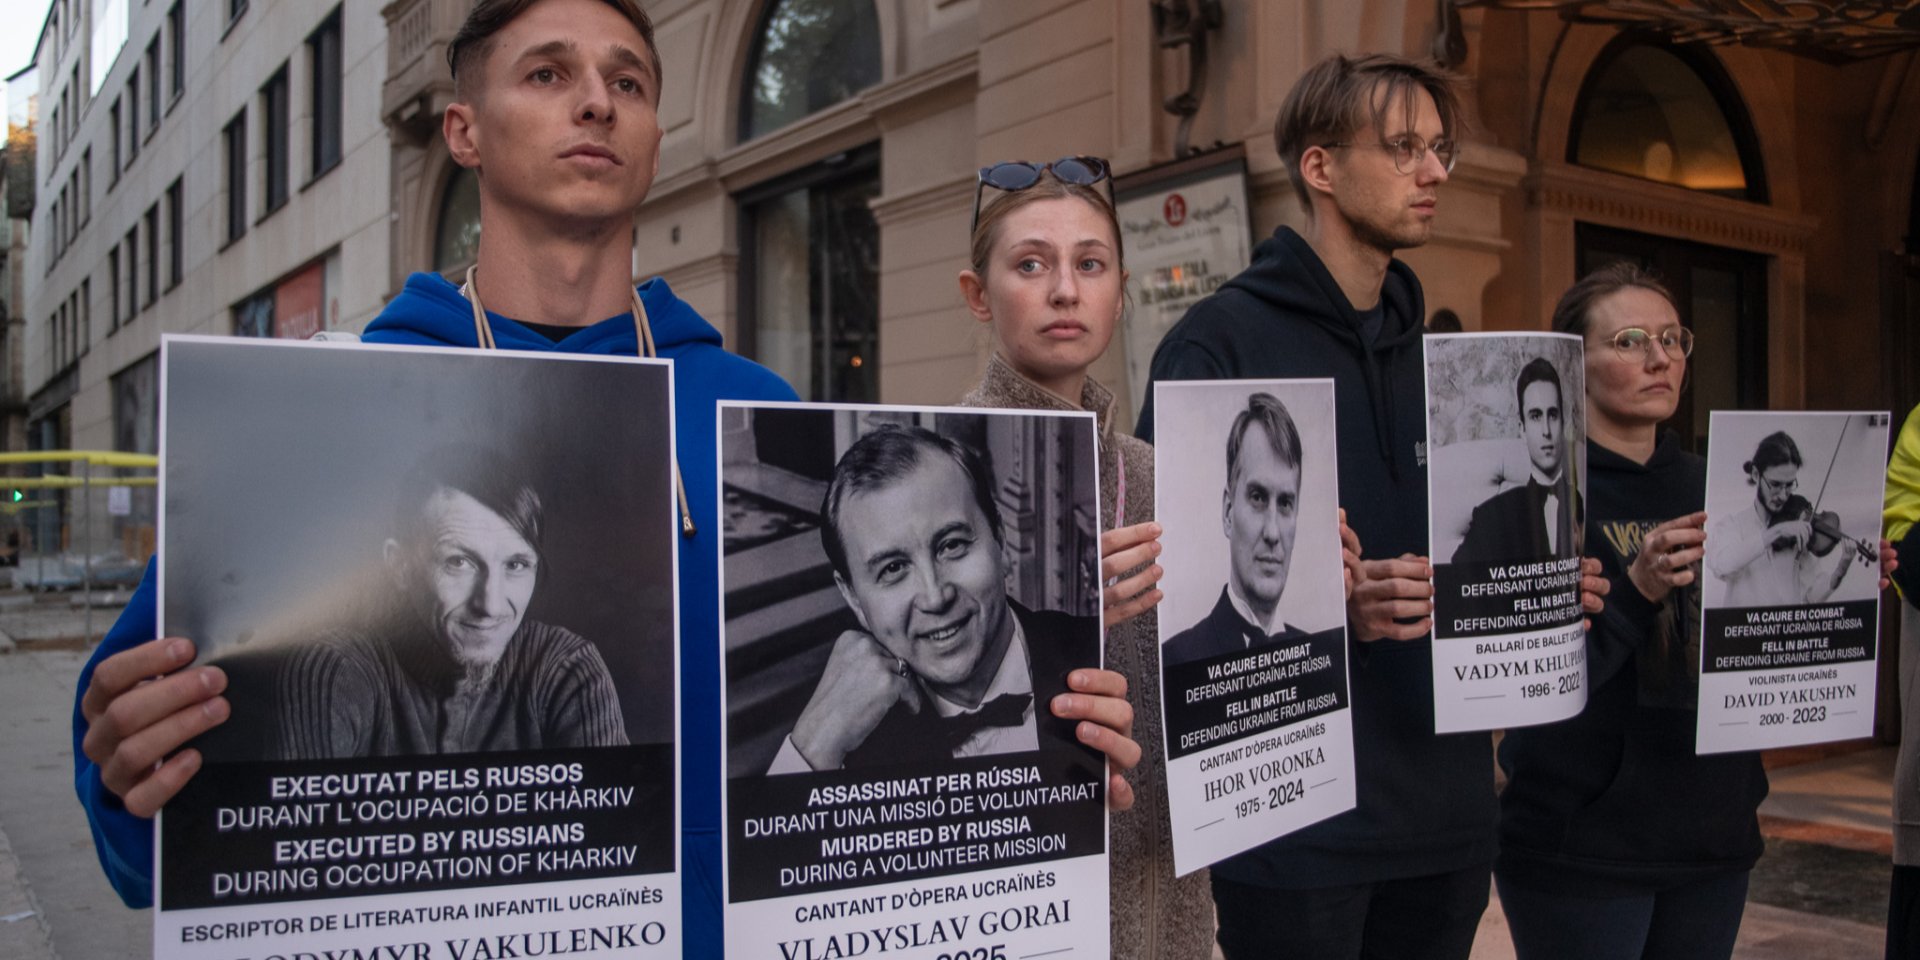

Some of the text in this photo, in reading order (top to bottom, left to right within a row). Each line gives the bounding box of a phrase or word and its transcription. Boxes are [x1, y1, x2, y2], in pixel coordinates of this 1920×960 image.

[1461, 579, 1532, 597] DEFENSANT
[1535, 572, 1569, 590] UCRAÏNA
[1569, 571, 1576, 581] DE
[1489, 568, 1507, 579] VA
[1508, 563, 1543, 578] CAURE
[1546, 561, 1557, 573] EN
[1454, 613, 1526, 631] DEFENDING
[1529, 608, 1565, 626] UKRAINE
[1514, 591, 1575, 611] FELL IN BATTLE
[1747, 607, 1844, 623] VA CAURE EN COMBAT
[1476, 638, 1524, 654] BALLARÍ
[1527, 639, 1539, 649] DE
[1543, 633, 1569, 647] BALLET
[1724, 617, 1863, 637] DEFENSANT UCRAÏNA DE RÚSSIA
[1762, 637, 1828, 652] FELL IN BATTLE
[1208, 643, 1310, 680] VA CAURE EN COMBAT
[1454, 661, 1528, 681] VADYM
[1716, 647, 1865, 668] DEFENDING UKRAINE FROM RUSSIA
[1186, 655, 1331, 703] DEFENSANT UCRAÏNA DE RÚSSIA
[1521, 682, 1550, 698] 1996
[1559, 671, 1579, 695] 2022
[1749, 669, 1837, 686] VIOLINISTA UCRAÏNÈS
[1226, 686, 1297, 717] FELL IN BATTLE
[1724, 684, 1856, 709] DAVID YAKUSHYN
[1181, 692, 1337, 749] DEFENDING UKRAINE FROM RUSSIA
[1760, 713, 1785, 726] 2000
[1792, 706, 1826, 724] 2023
[1200, 723, 1325, 772] CANTANT D'ÒPERA UCRAÏNÈS
[272, 763, 583, 798] EXECUTAT PELS RUSSOS
[808, 766, 1041, 807] ASSASSINAT PER RÚSSIA
[1205, 747, 1325, 802] IHOR VORONKA
[218, 786, 634, 831] DURANT L'OCUPACIÓ DE KHÀRKIV
[744, 782, 1099, 838] DURANT UNA MISSIÓ DE VOLUNTARIAT
[1235, 797, 1260, 819] 1975
[1269, 779, 1304, 810] 2024
[275, 823, 584, 863] EXECUTED BY RUSSIANS
[821, 816, 1031, 858] MURDERED BY RUSSIA
[213, 845, 637, 897] DURING OCCUPATION OF KHARKIV
[781, 834, 1066, 887] DURING A VOLUNTEER MISSION
[182, 886, 664, 943] ESCRIPTOR DE LITERATURA INFANTIL UCRAÏNÈS
[795, 872, 1055, 923] CANTANT D'ÒPERA UCRAÏNÈS
[443, 921, 666, 960] VAKULENKO
[777, 900, 1071, 960] VLADYSLAV GORAI
